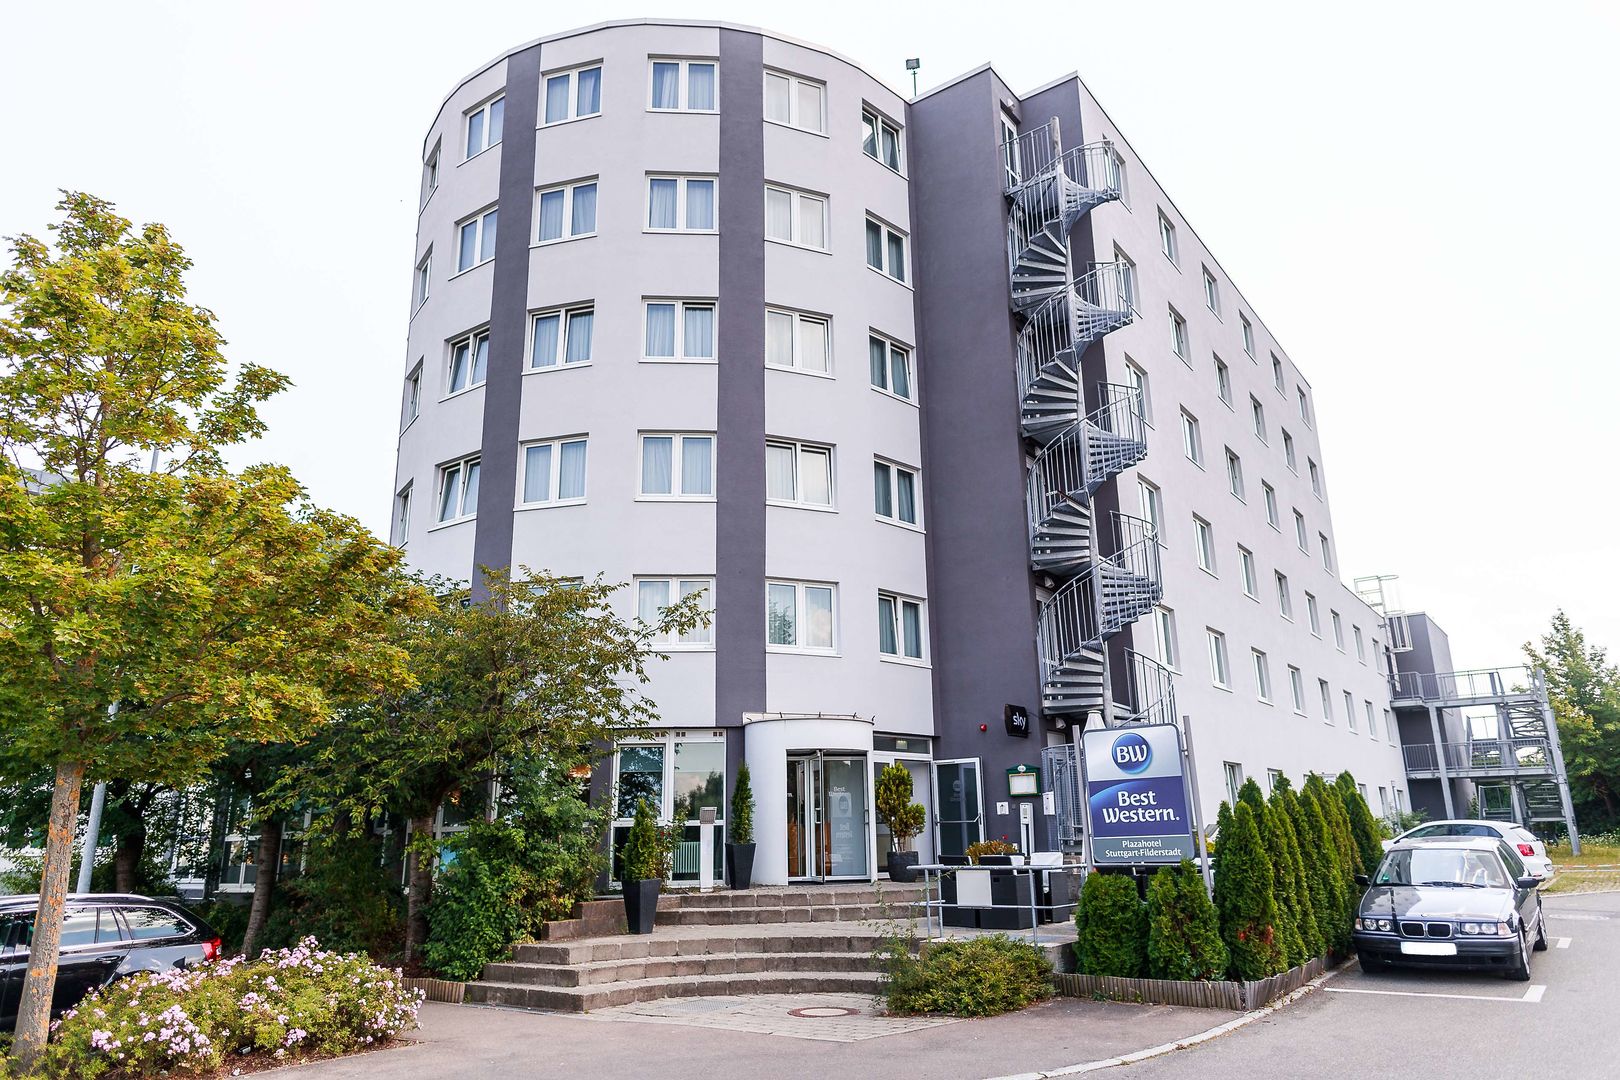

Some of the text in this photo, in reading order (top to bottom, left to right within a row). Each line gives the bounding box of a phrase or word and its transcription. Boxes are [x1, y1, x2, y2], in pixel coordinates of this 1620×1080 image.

[1012, 711, 1026, 730] sky
[1116, 745, 1147, 764] BW
[1117, 790, 1157, 806] Best
[1103, 806, 1180, 824] Western.
[1122, 839, 1162, 848] Plazahotel
[1105, 847, 1182, 859] Stuttgart-Filderstadt
